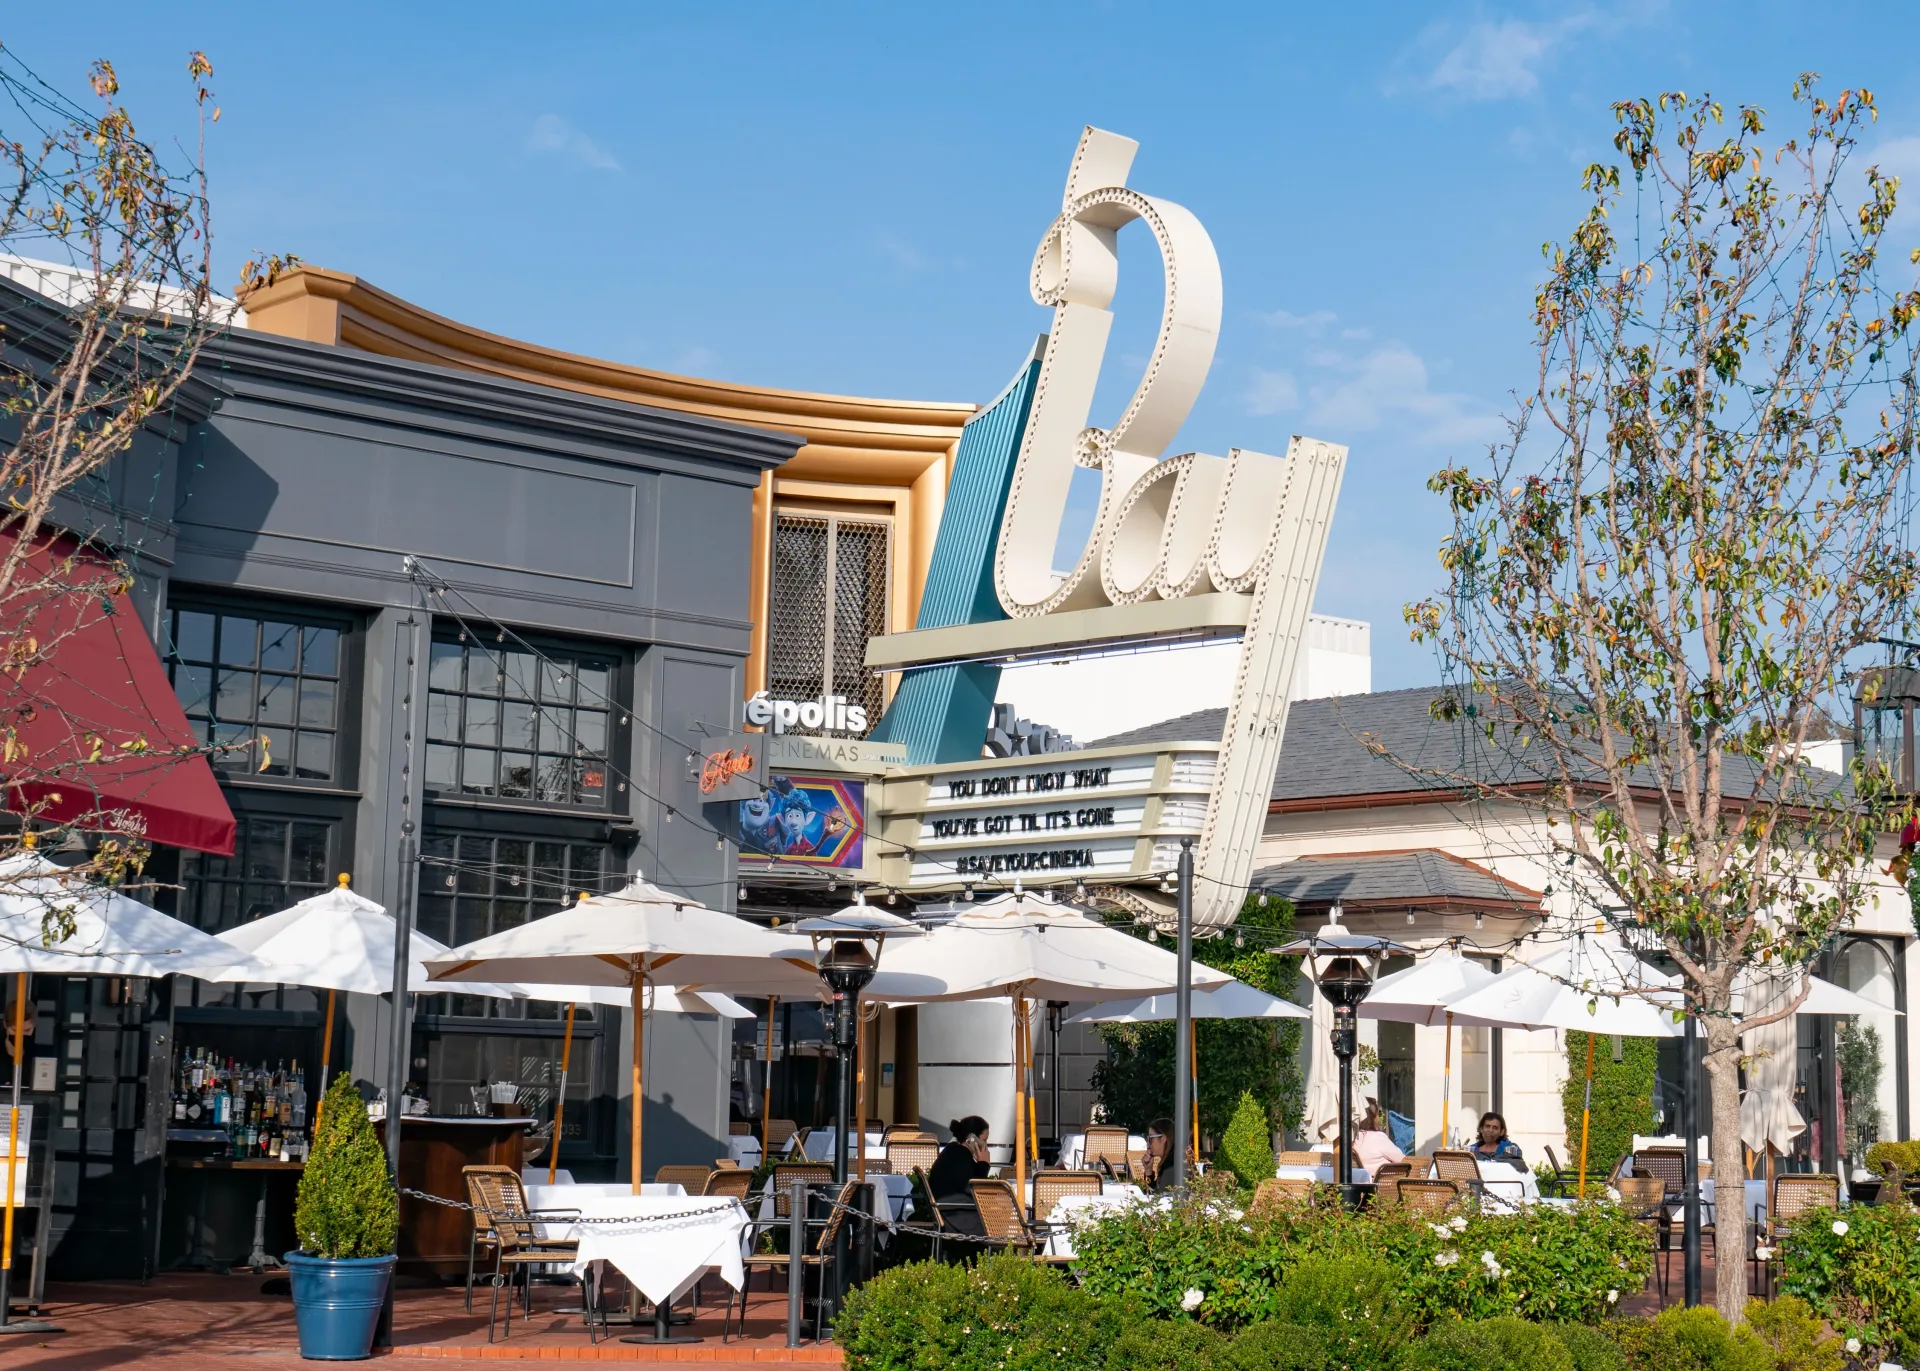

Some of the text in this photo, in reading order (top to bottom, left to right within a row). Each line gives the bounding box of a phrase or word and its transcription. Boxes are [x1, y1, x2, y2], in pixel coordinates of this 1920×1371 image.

[743, 691, 867, 735] épolis
[948, 779, 976, 798] YOU
[1026, 771, 1067, 792] KNOW
[1071, 767, 1112, 788] WHAT
[932, 818, 978, 838] YOU'VE
[984, 815, 1013, 834] GOT
[1045, 810, 1072, 829] IT'S
[1076, 807, 1115, 827] GONE
[956, 849, 1094, 874] #SAVEYOURCINEMA
[1857, 1125, 1879, 1143] PAIGE
